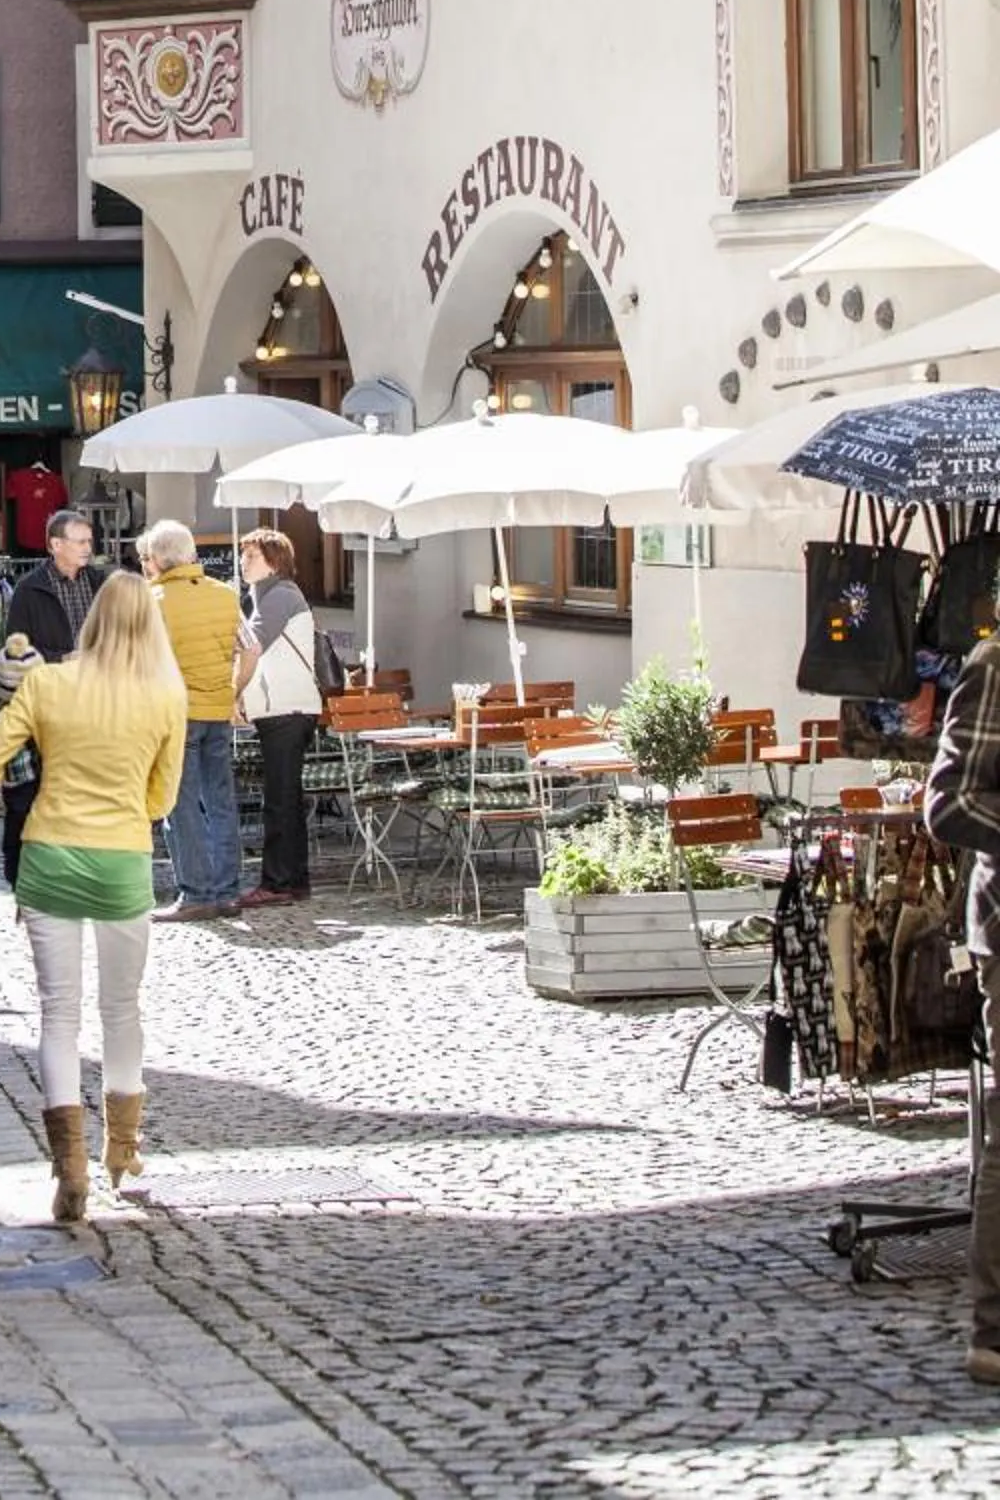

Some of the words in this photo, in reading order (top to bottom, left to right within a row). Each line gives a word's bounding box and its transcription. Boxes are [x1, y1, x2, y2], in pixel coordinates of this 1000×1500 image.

[240, 167, 304, 236] CAFÉ
[421, 136, 625, 304] RESTAURANT
[837, 441, 898, 472] TIROL
